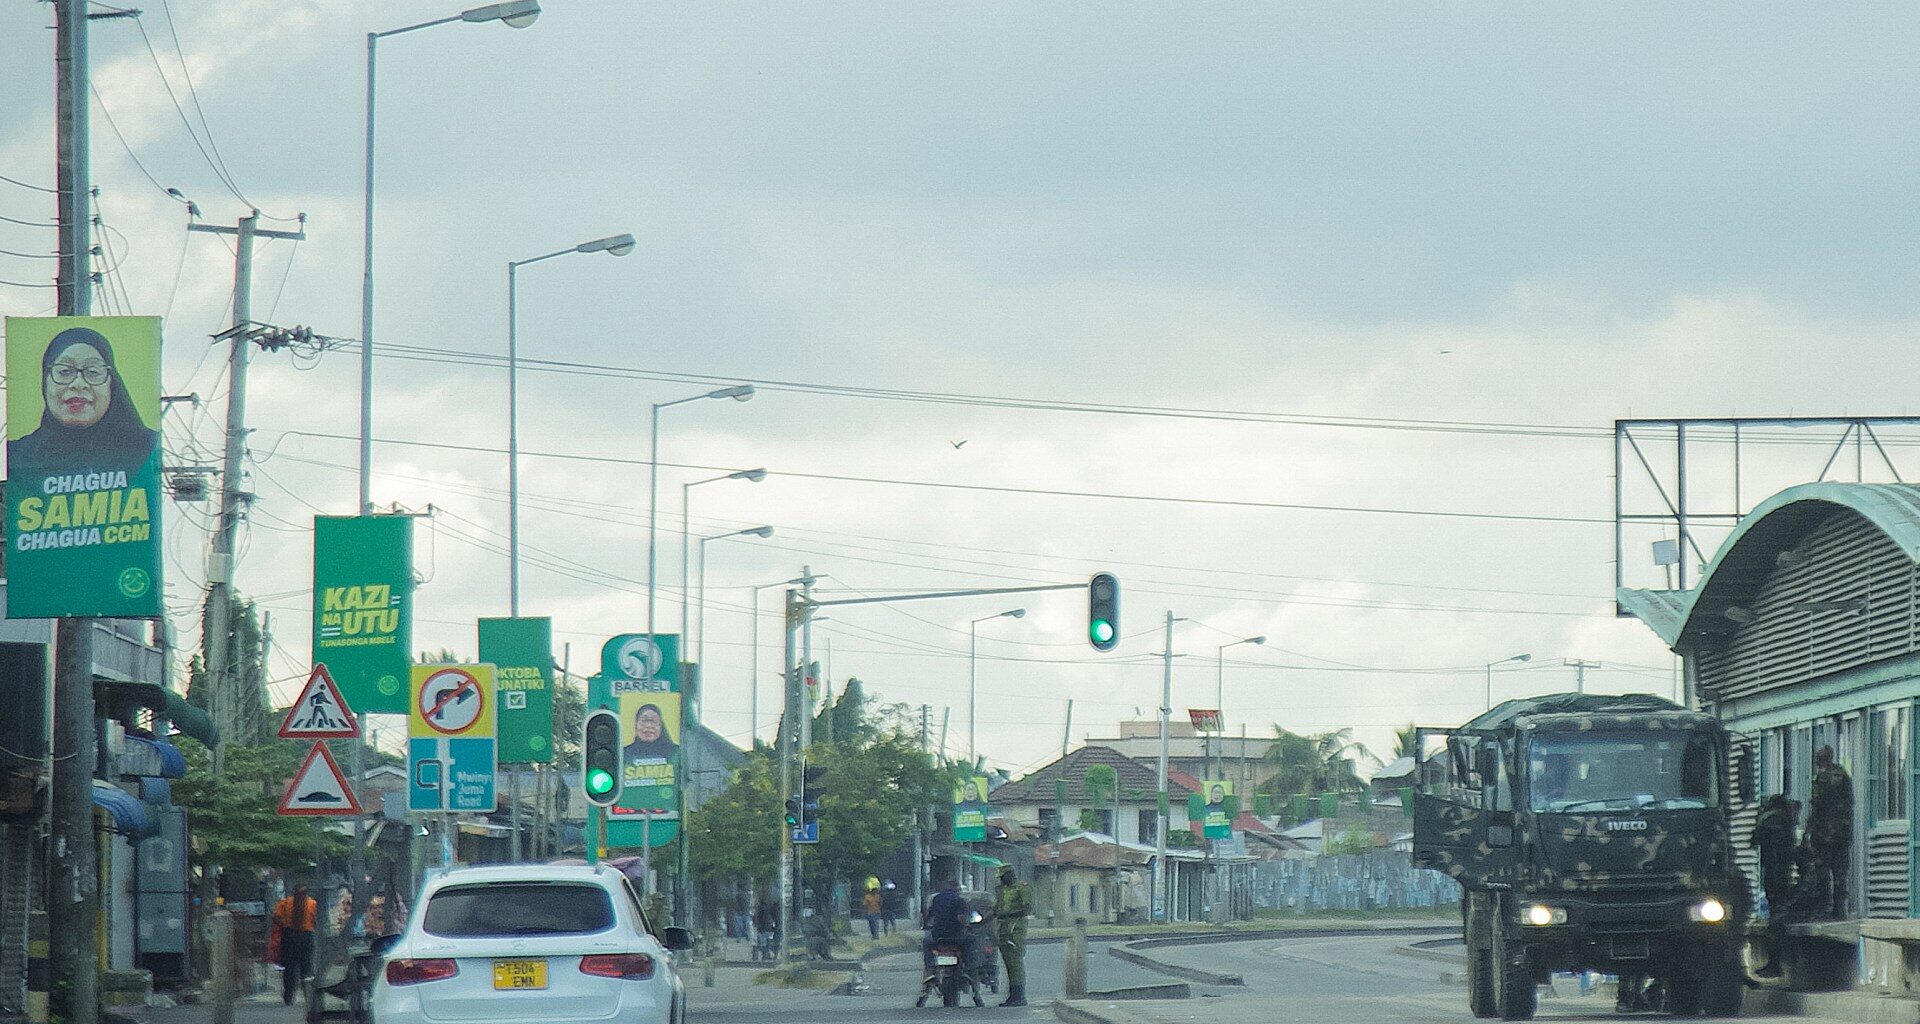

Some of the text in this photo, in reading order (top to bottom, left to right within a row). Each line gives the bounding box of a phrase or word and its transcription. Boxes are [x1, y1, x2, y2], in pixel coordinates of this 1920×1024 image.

[43, 471, 127, 494] CHAGUA
[18, 488, 149, 531] SAMIA
[17, 523, 150, 551] CHAGUA CCM
[324, 585, 390, 611] KAZI
[322, 608, 399, 634] NA UTU
[497, 679, 544, 690] UNATIKI
[615, 681, 667, 691] BARREL
[625, 764, 674, 779] SAMIA
[457, 795, 482, 807] Road
[1608, 820, 1648, 830] IVECO
